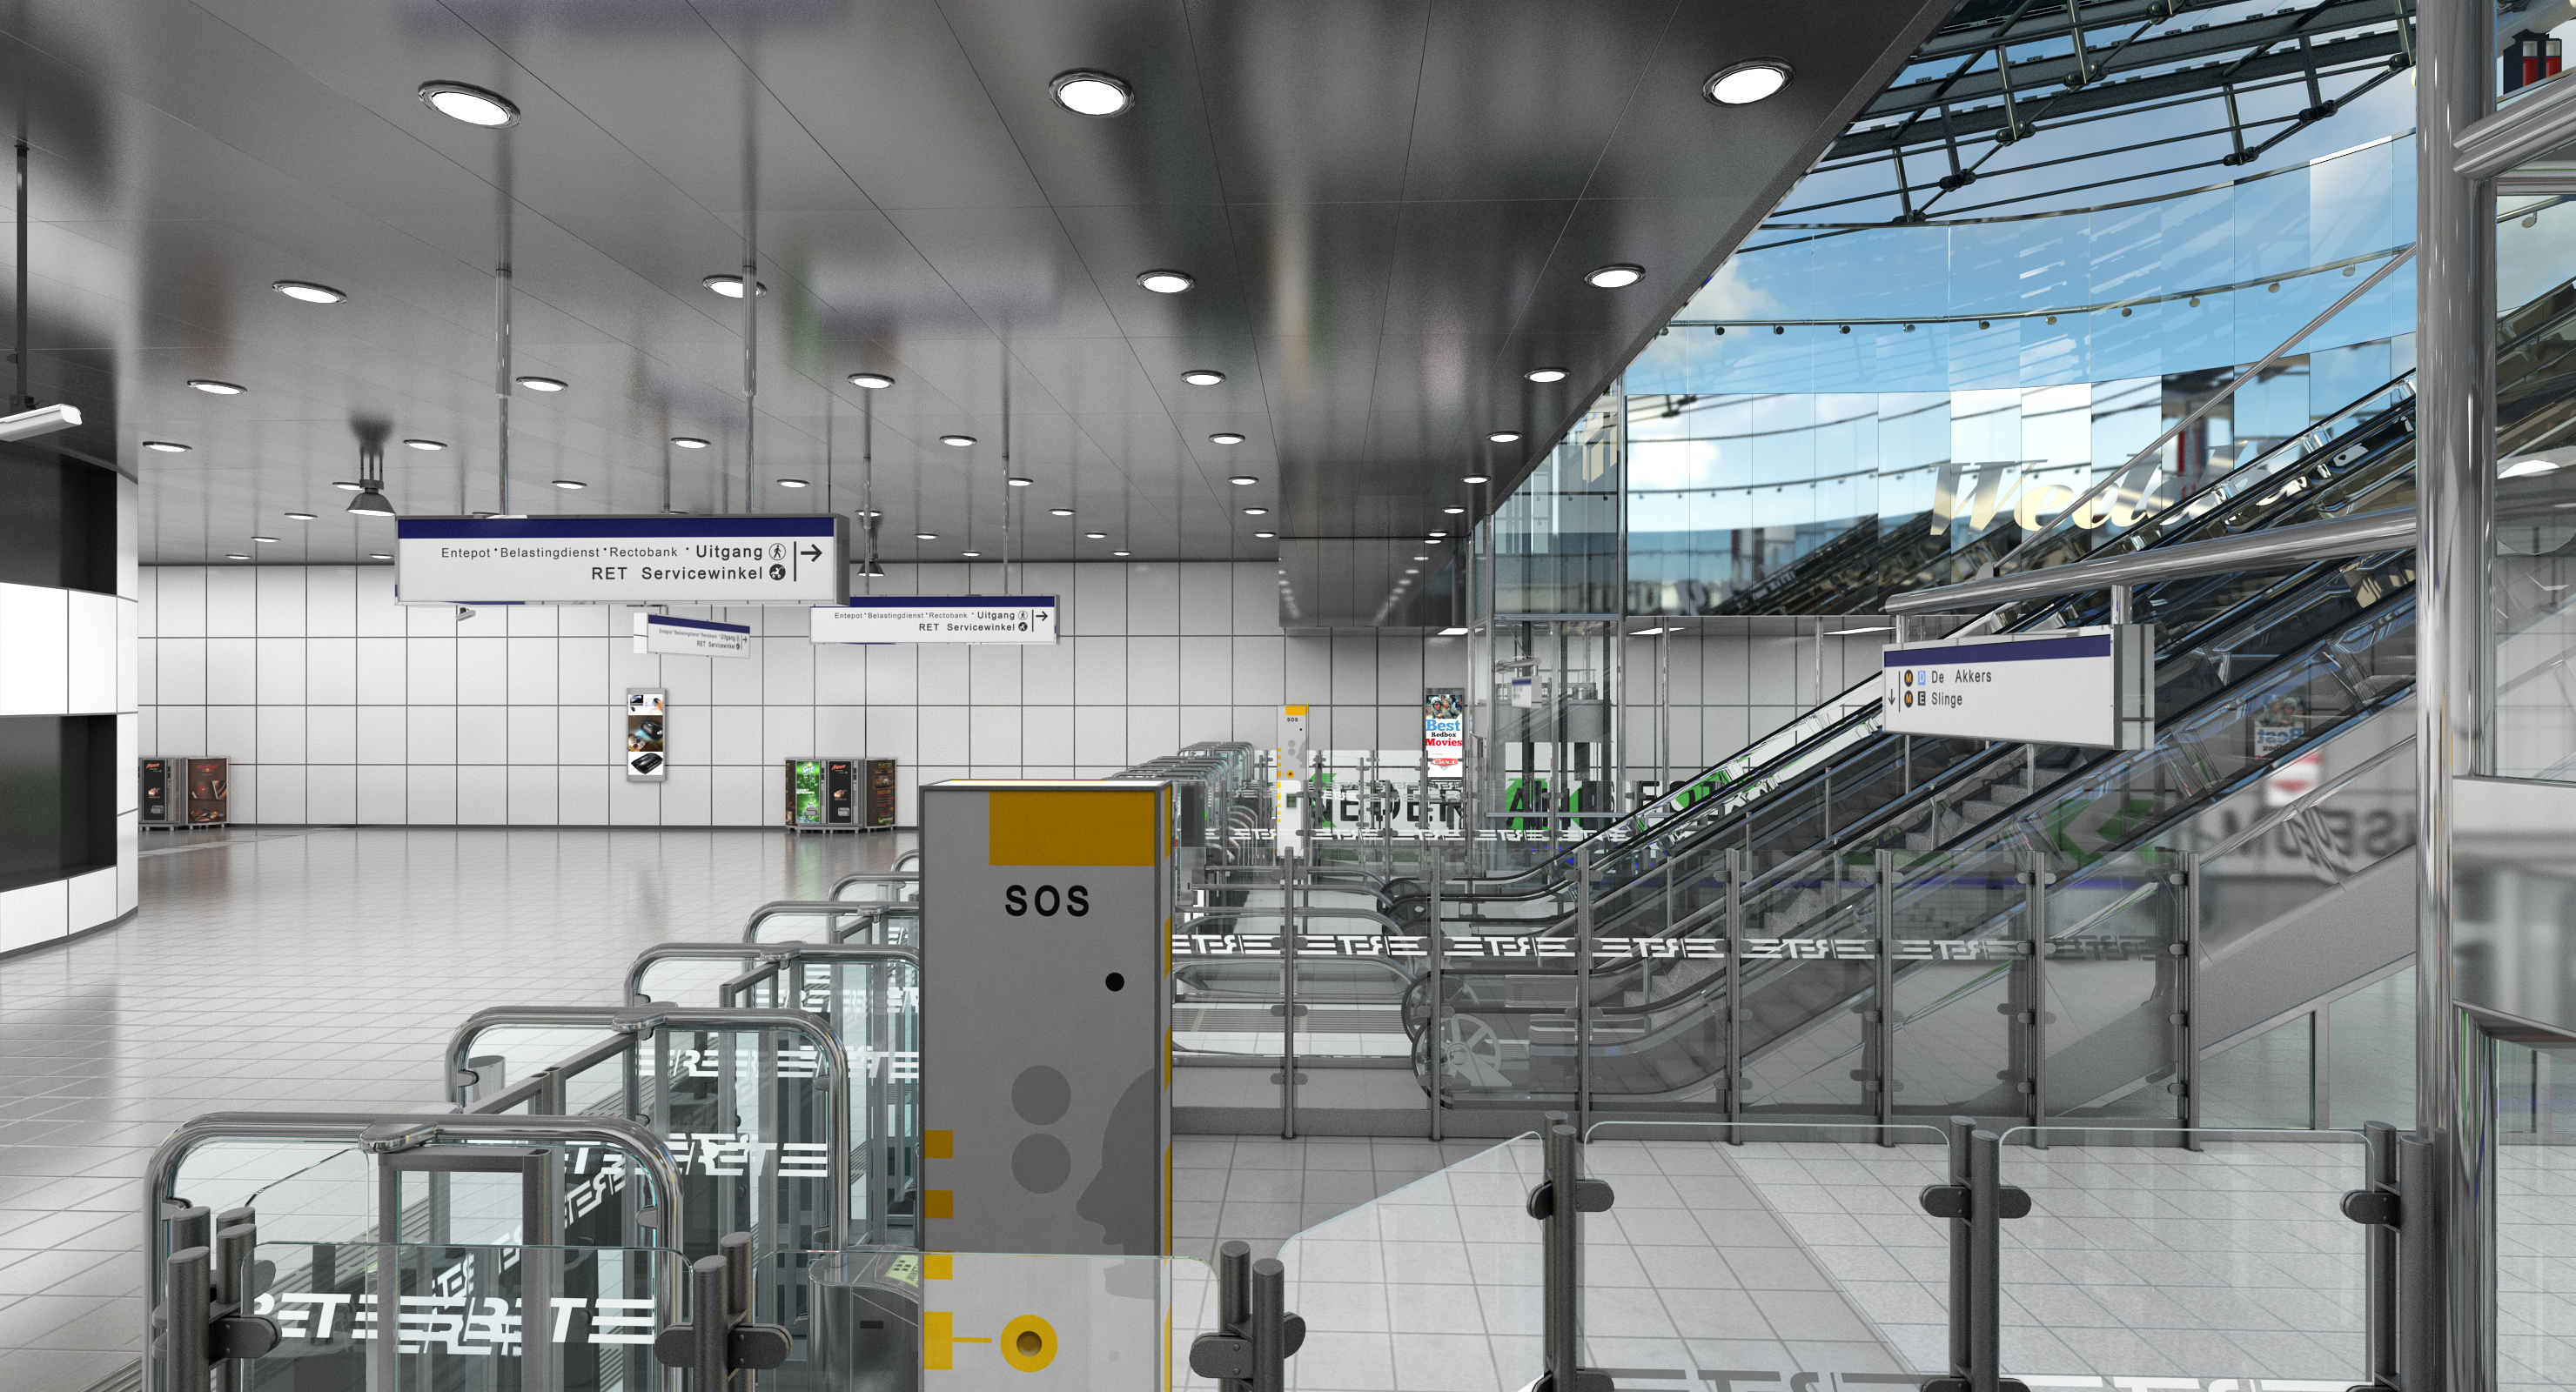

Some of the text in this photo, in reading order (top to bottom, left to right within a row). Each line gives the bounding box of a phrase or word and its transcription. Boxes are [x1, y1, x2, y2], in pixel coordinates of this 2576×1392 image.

[441, 545, 762, 560] Entepot Belastingdienst Rectobank Uitgang
[592, 566, 762, 579] RET Servicewinkel
[868, 612, 924, 620] Belastingdienst
[977, 611, 1015, 620] Uitgang
[947, 623, 1015, 632] Servicewinkel
[721, 633, 735, 642] Uitgang
[1931, 670, 1944, 684] De
[1955, 669, 1992, 684] Akkers
[1931, 692, 1962, 709] Slinge
[1426, 719, 1461, 732] Best
[1426, 738, 1463, 746] Movies
[1005, 885, 1090, 917] SOS
